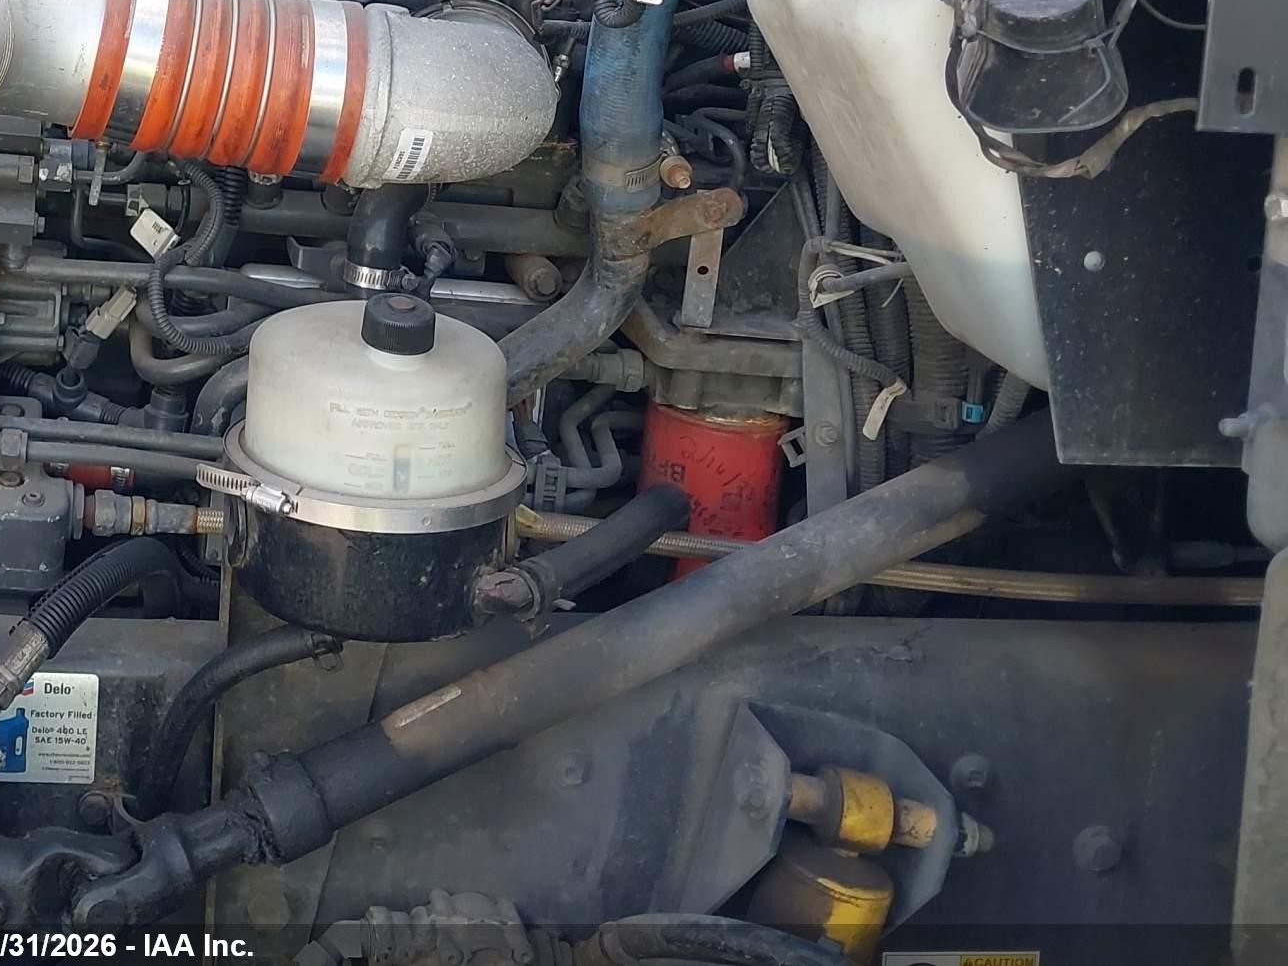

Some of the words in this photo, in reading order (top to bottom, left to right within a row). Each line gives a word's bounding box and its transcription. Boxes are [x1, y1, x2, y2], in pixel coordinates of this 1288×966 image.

[30, 709, 65, 720] Factory
[67, 710, 92, 720] Filled
[76, 728, 88, 736] LE
[34, 736, 53, 744] SAE
[55, 737, 87, 745] 15W-40
